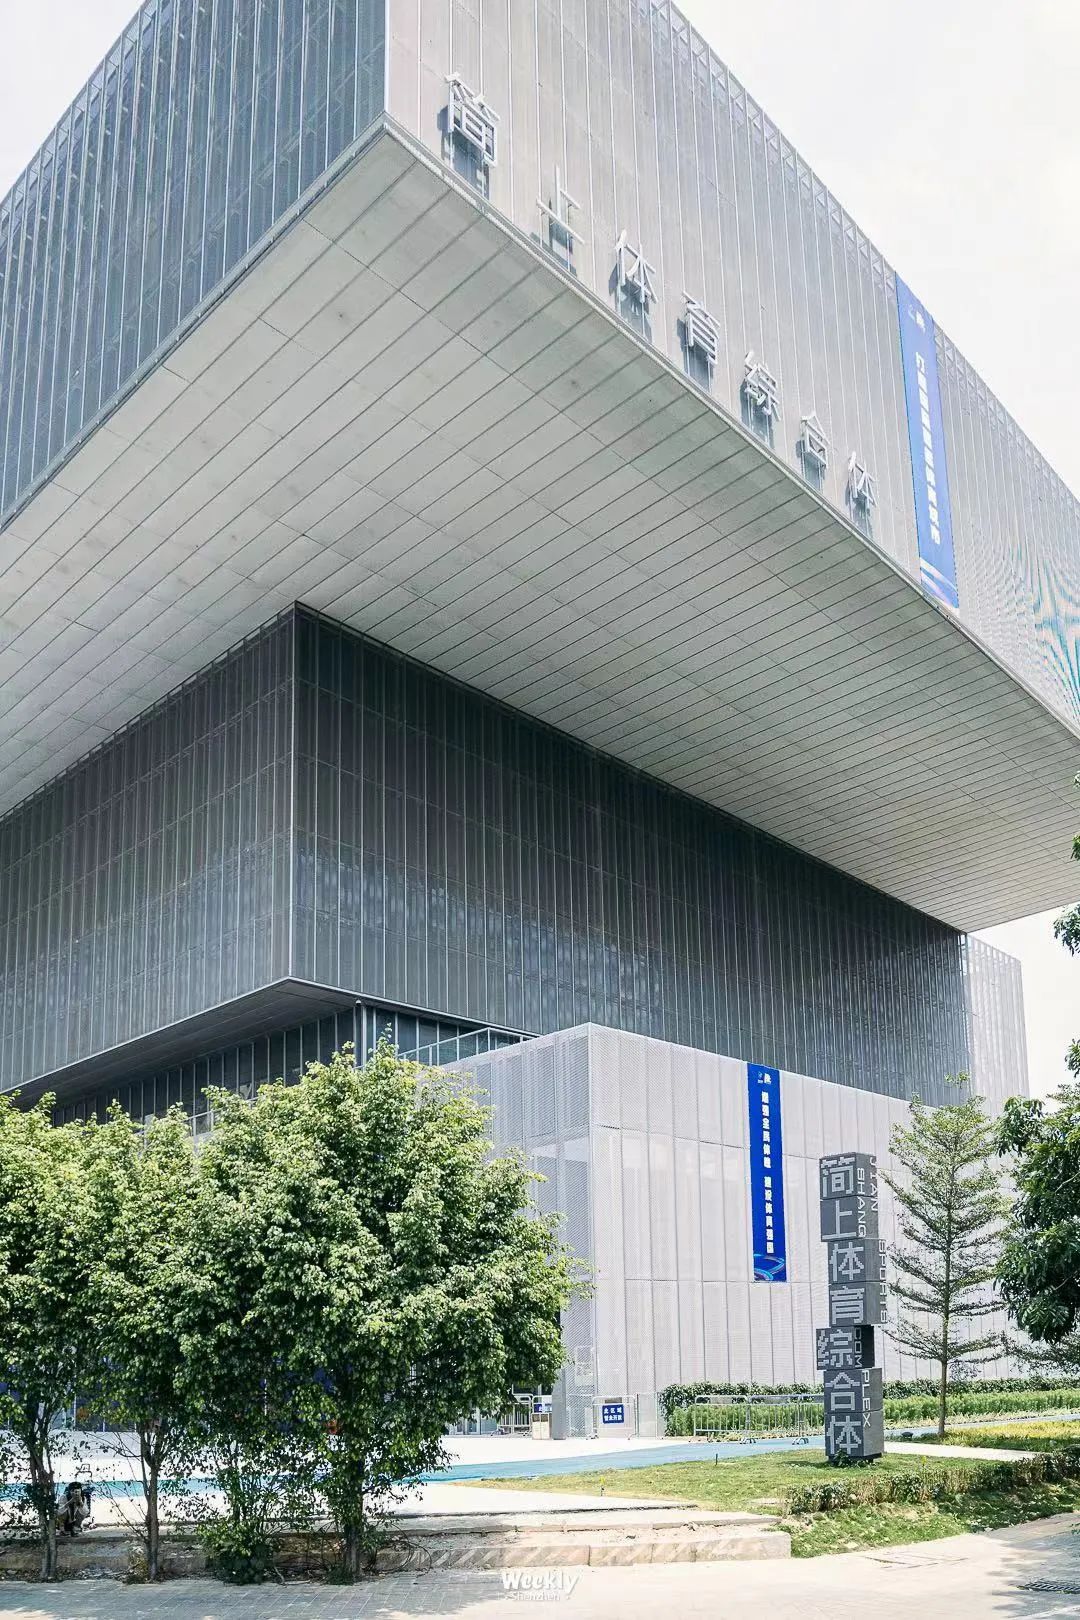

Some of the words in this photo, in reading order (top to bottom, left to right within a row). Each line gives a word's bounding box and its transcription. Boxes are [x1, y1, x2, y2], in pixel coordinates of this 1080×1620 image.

[445, 73, 876, 508] 简上体育综合体
[857, 1167, 867, 1238] SHANG
[870, 1156, 879, 1212] JIAN
[818, 1157, 864, 1456] 简上体育综合体
[879, 1239, 888, 1323] SPORTS
[855, 1327, 863, 1368] COM
[861, 1368, 870, 1428] PLEX
